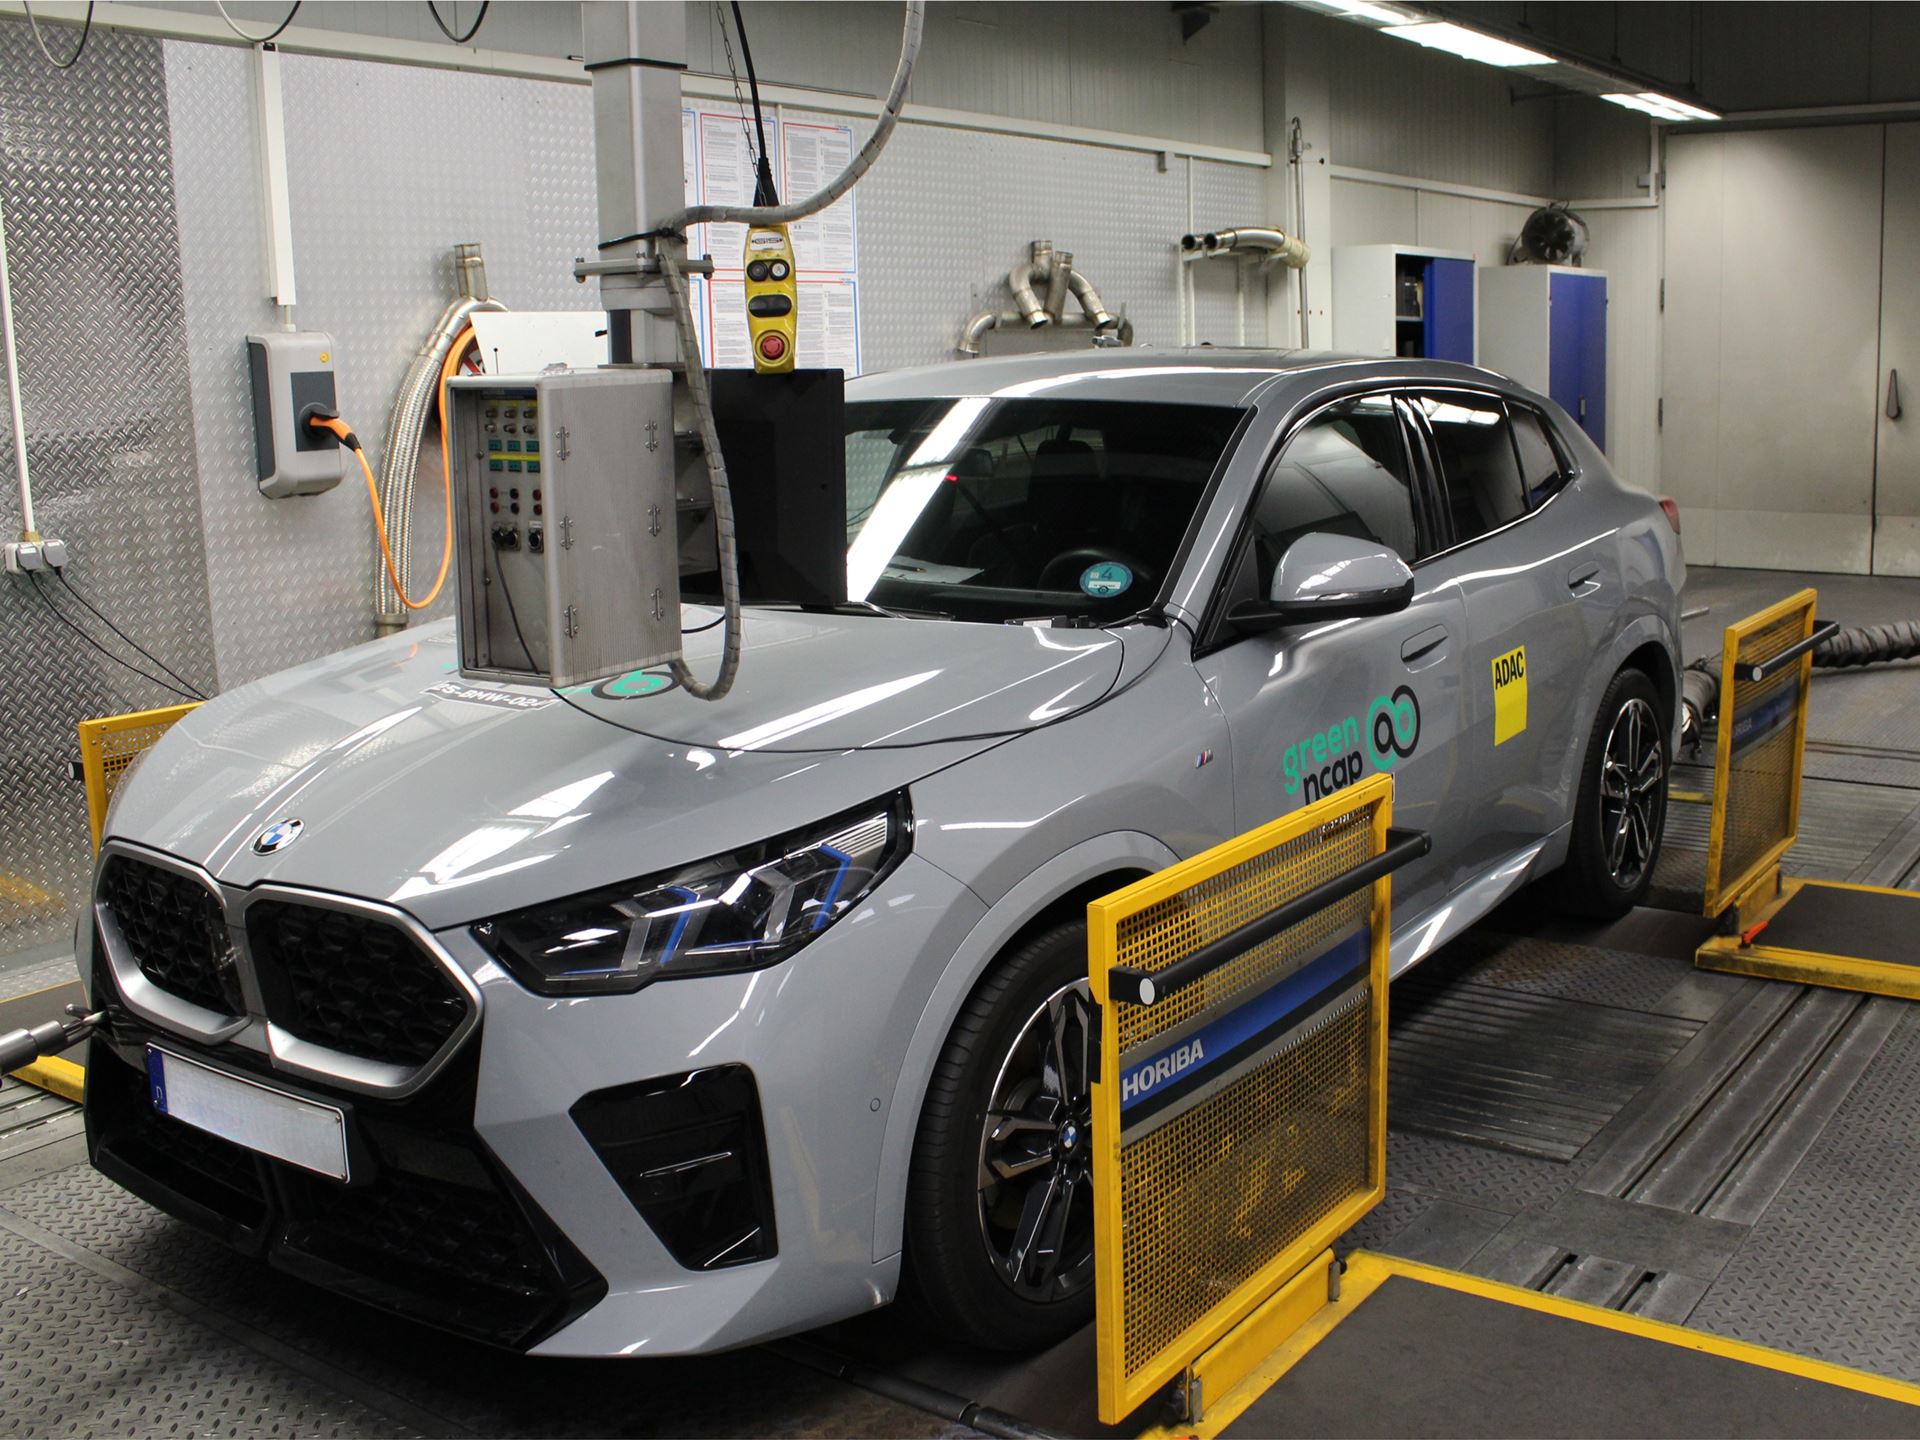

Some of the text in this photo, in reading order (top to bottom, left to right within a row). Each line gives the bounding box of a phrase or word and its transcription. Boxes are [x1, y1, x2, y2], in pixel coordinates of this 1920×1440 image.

[1101, 566, 1113, 579] 4
[1495, 651, 1524, 690] ADAC
[1283, 716, 1360, 795] green
[1303, 751, 1363, 805] ncap
[1122, 1038, 1204, 1102] HORIBA
